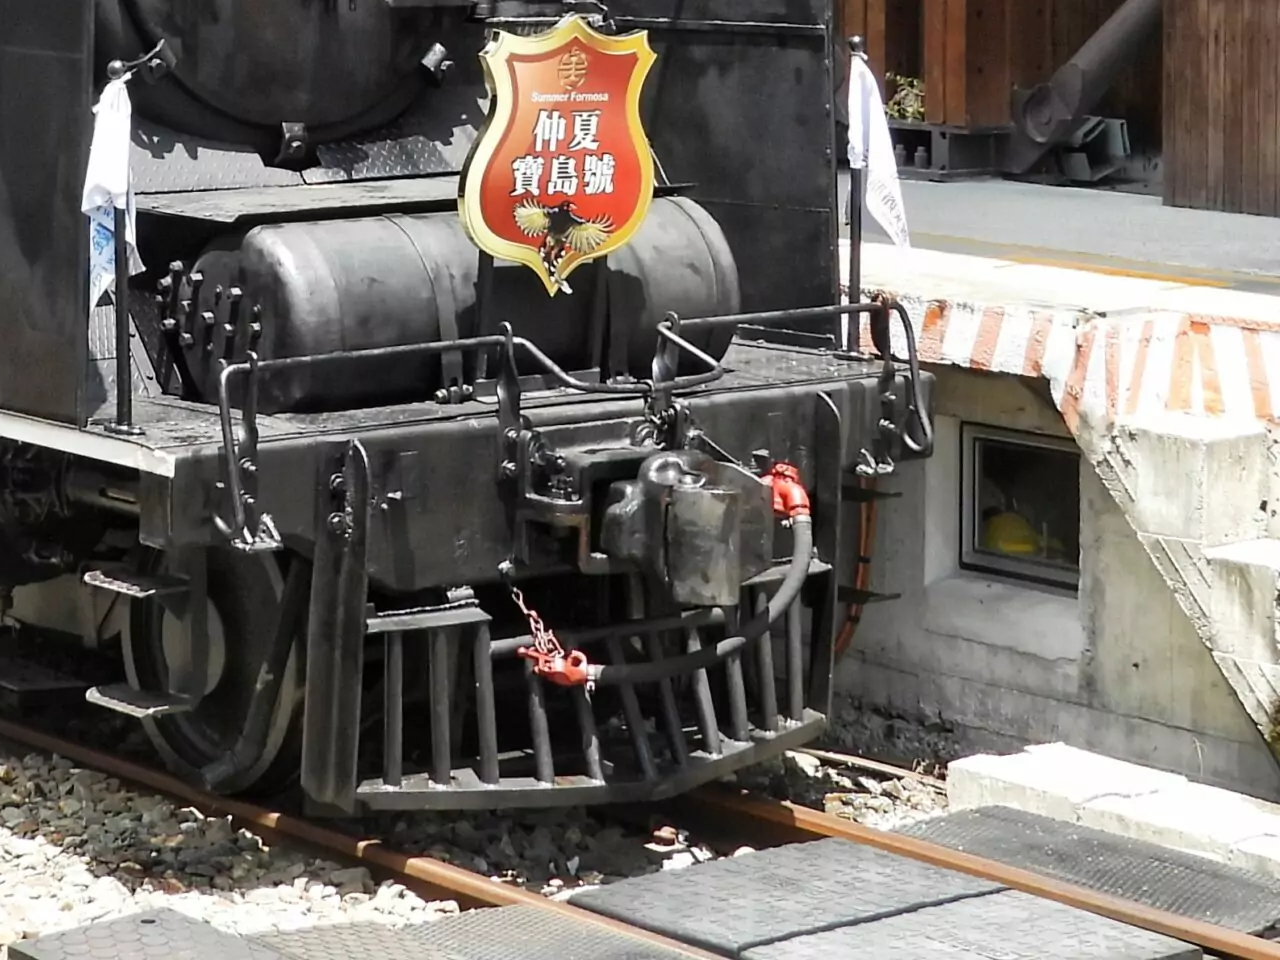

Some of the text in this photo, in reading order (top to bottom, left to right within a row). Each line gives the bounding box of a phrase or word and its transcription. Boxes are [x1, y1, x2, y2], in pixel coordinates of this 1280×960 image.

[531, 91, 609, 102] Summer Formosa
[533, 109, 601, 151] 仲夏
[510, 153, 616, 196] 寶島號
